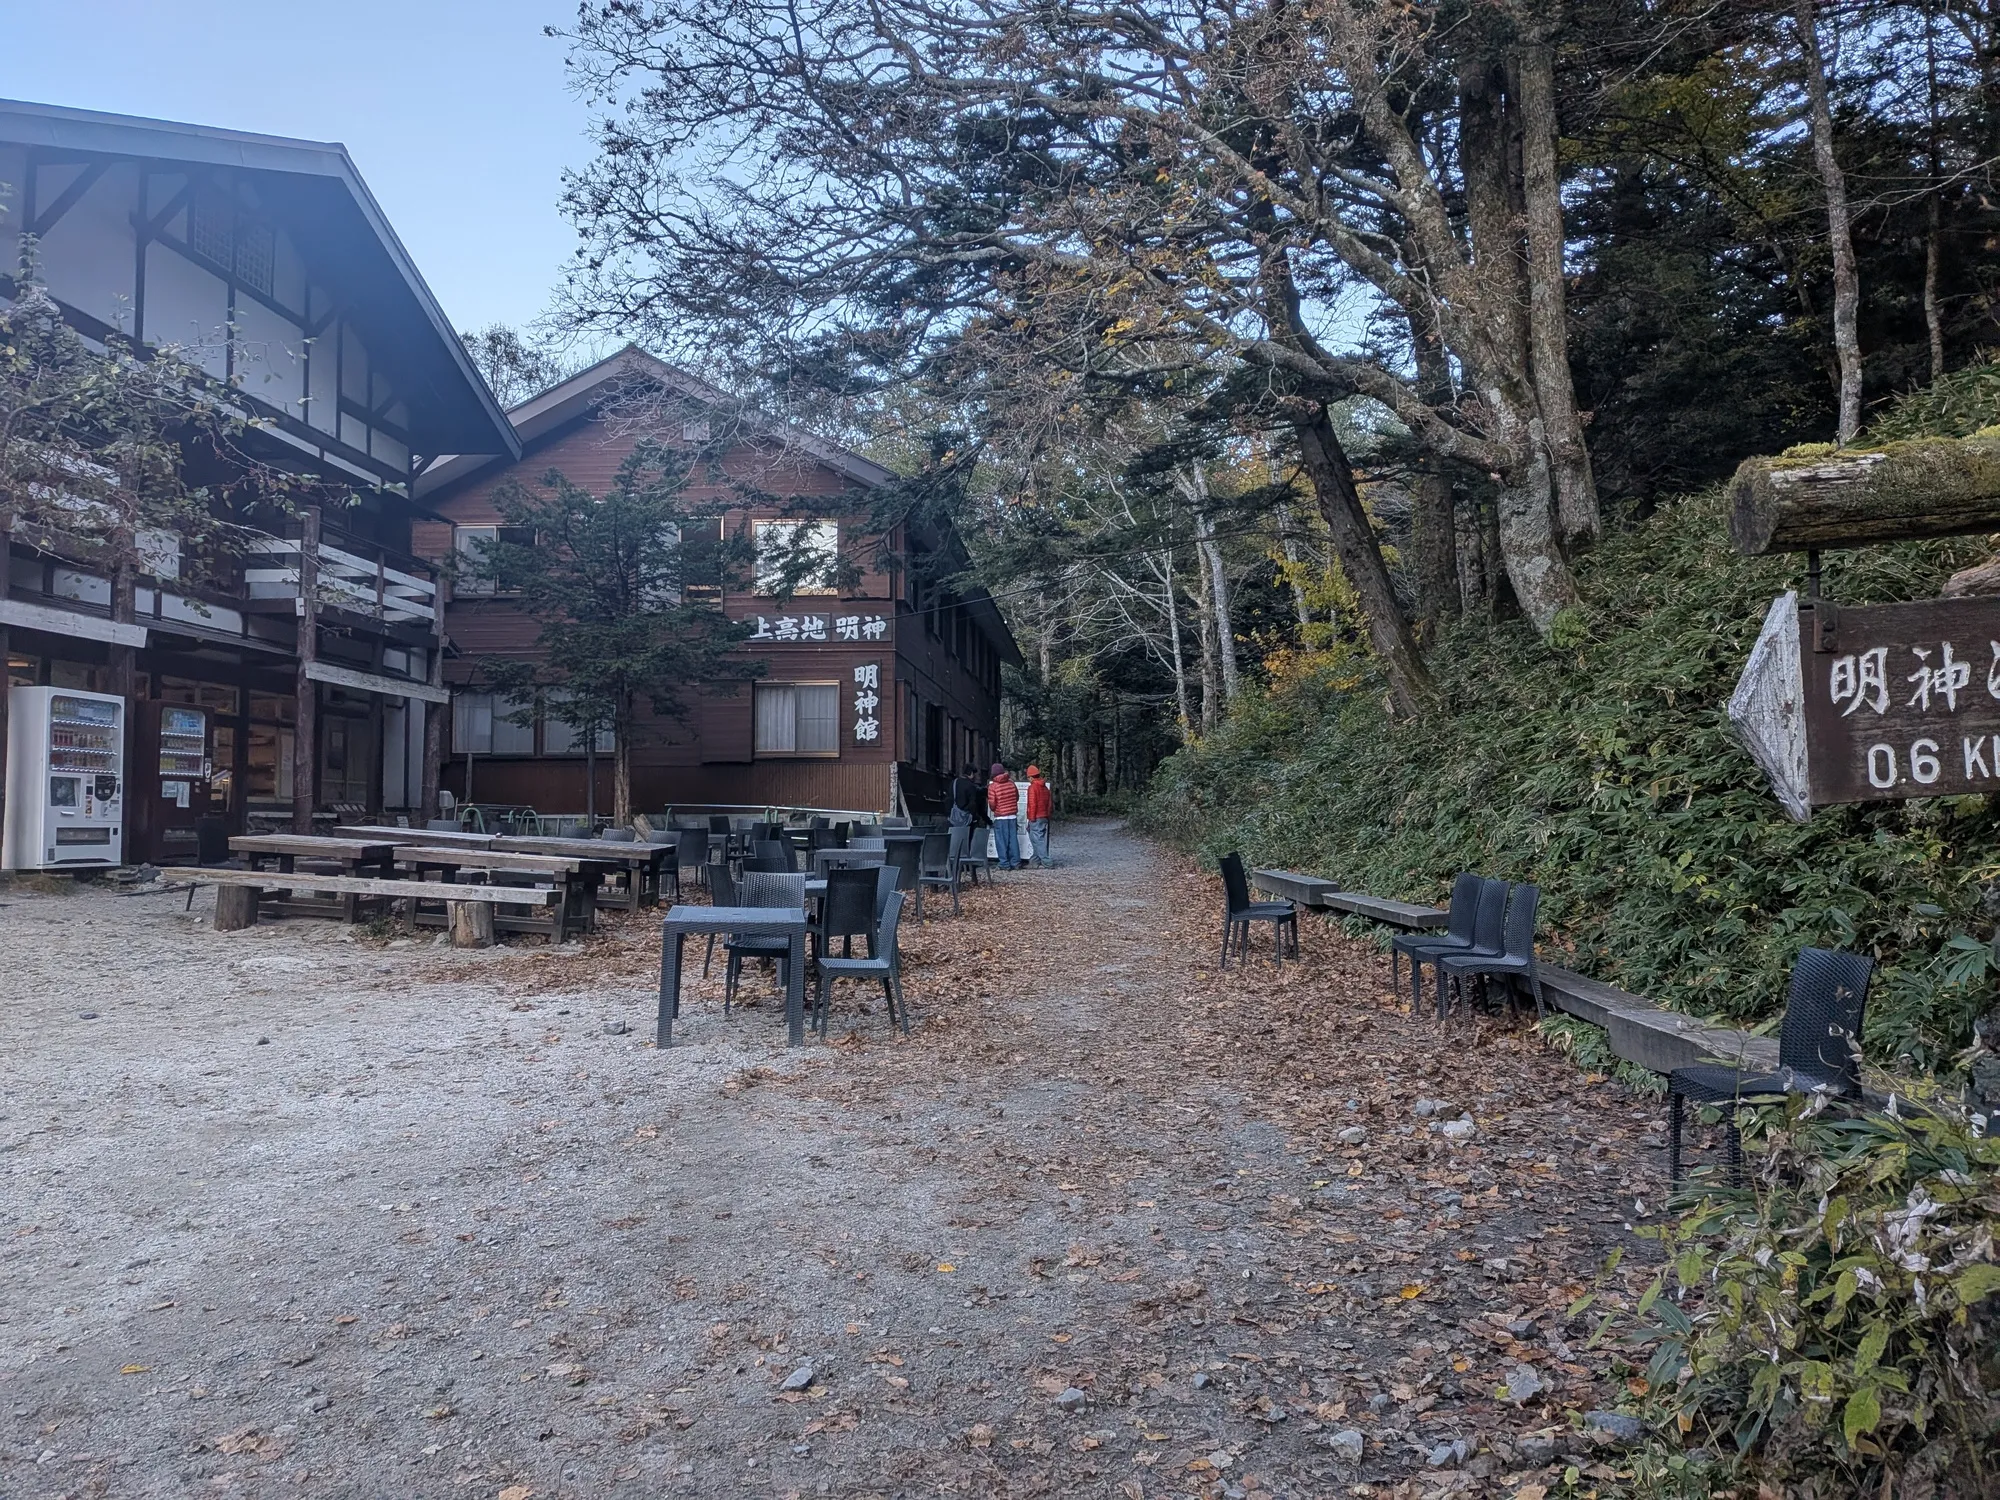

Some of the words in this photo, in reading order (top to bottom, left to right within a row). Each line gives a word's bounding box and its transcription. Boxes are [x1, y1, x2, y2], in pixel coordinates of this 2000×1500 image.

[750, 616, 827, 641] 上高地
[835, 615, 887, 640] 明神
[853, 664, 880, 741] 明神館
[1830, 640, 2000, 717] 明神
[1868, 738, 1941, 788] 0.6
